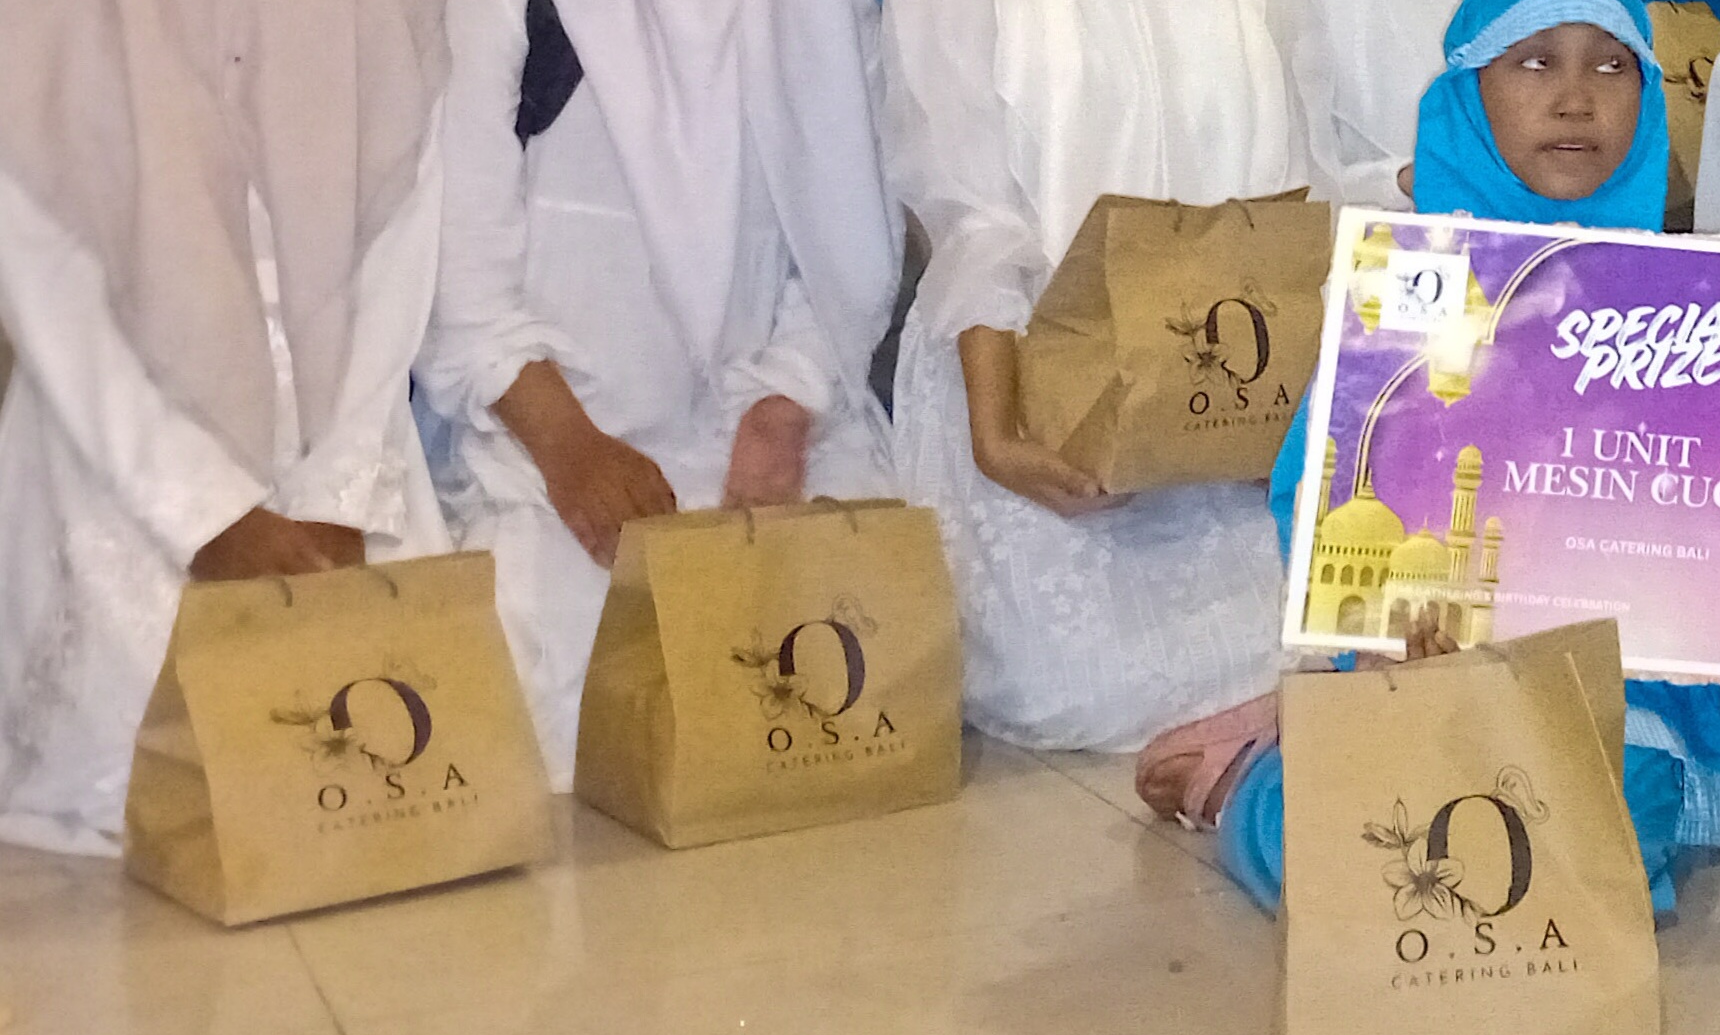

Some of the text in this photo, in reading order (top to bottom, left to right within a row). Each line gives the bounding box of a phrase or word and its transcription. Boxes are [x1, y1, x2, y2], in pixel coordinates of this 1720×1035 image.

[1561, 426, 1702, 468] 1 UNIT
[1502, 460, 1640, 503] MESIN
[1564, 536, 1710, 560] OSA CATERING BALI
[1391, 959, 1578, 991] CATERING BALI
